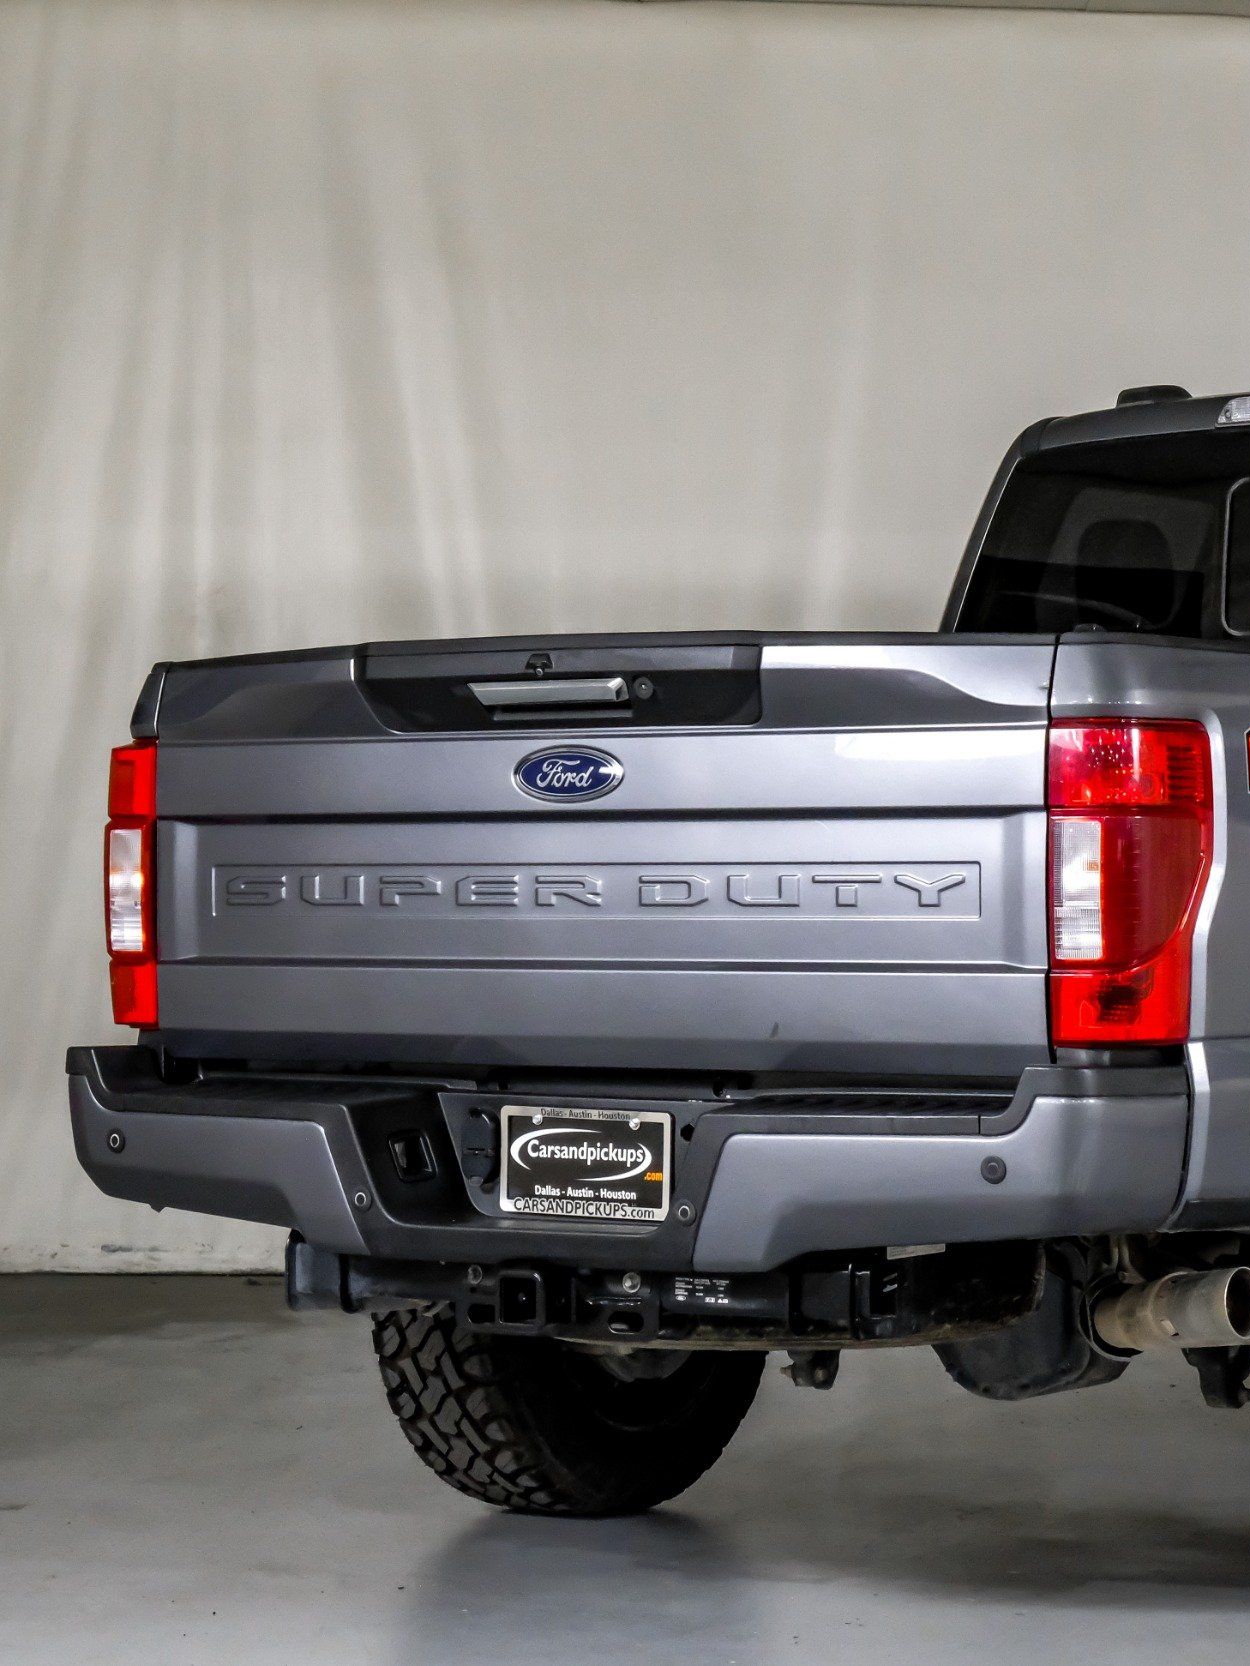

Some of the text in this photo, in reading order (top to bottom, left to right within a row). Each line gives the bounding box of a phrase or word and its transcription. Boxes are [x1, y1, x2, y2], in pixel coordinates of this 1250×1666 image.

[536, 759, 595, 788] Ford
[226, 874, 966, 908] SUPER DUTY
[541, 1108, 563, 1118] Dallas
[568, 1109, 592, 1119] Austin
[598, 1111, 631, 1120] Houston
[527, 1139, 644, 1168] Carsandpickups
[644, 1171, 662, 1182] .com
[534, 1185, 561, 1196] Dallas
[566, 1187, 594, 1198] Austin
[600, 1188, 637, 1200] Houston
[514, 1197, 655, 1219] CARSANDPICKUPS.com
